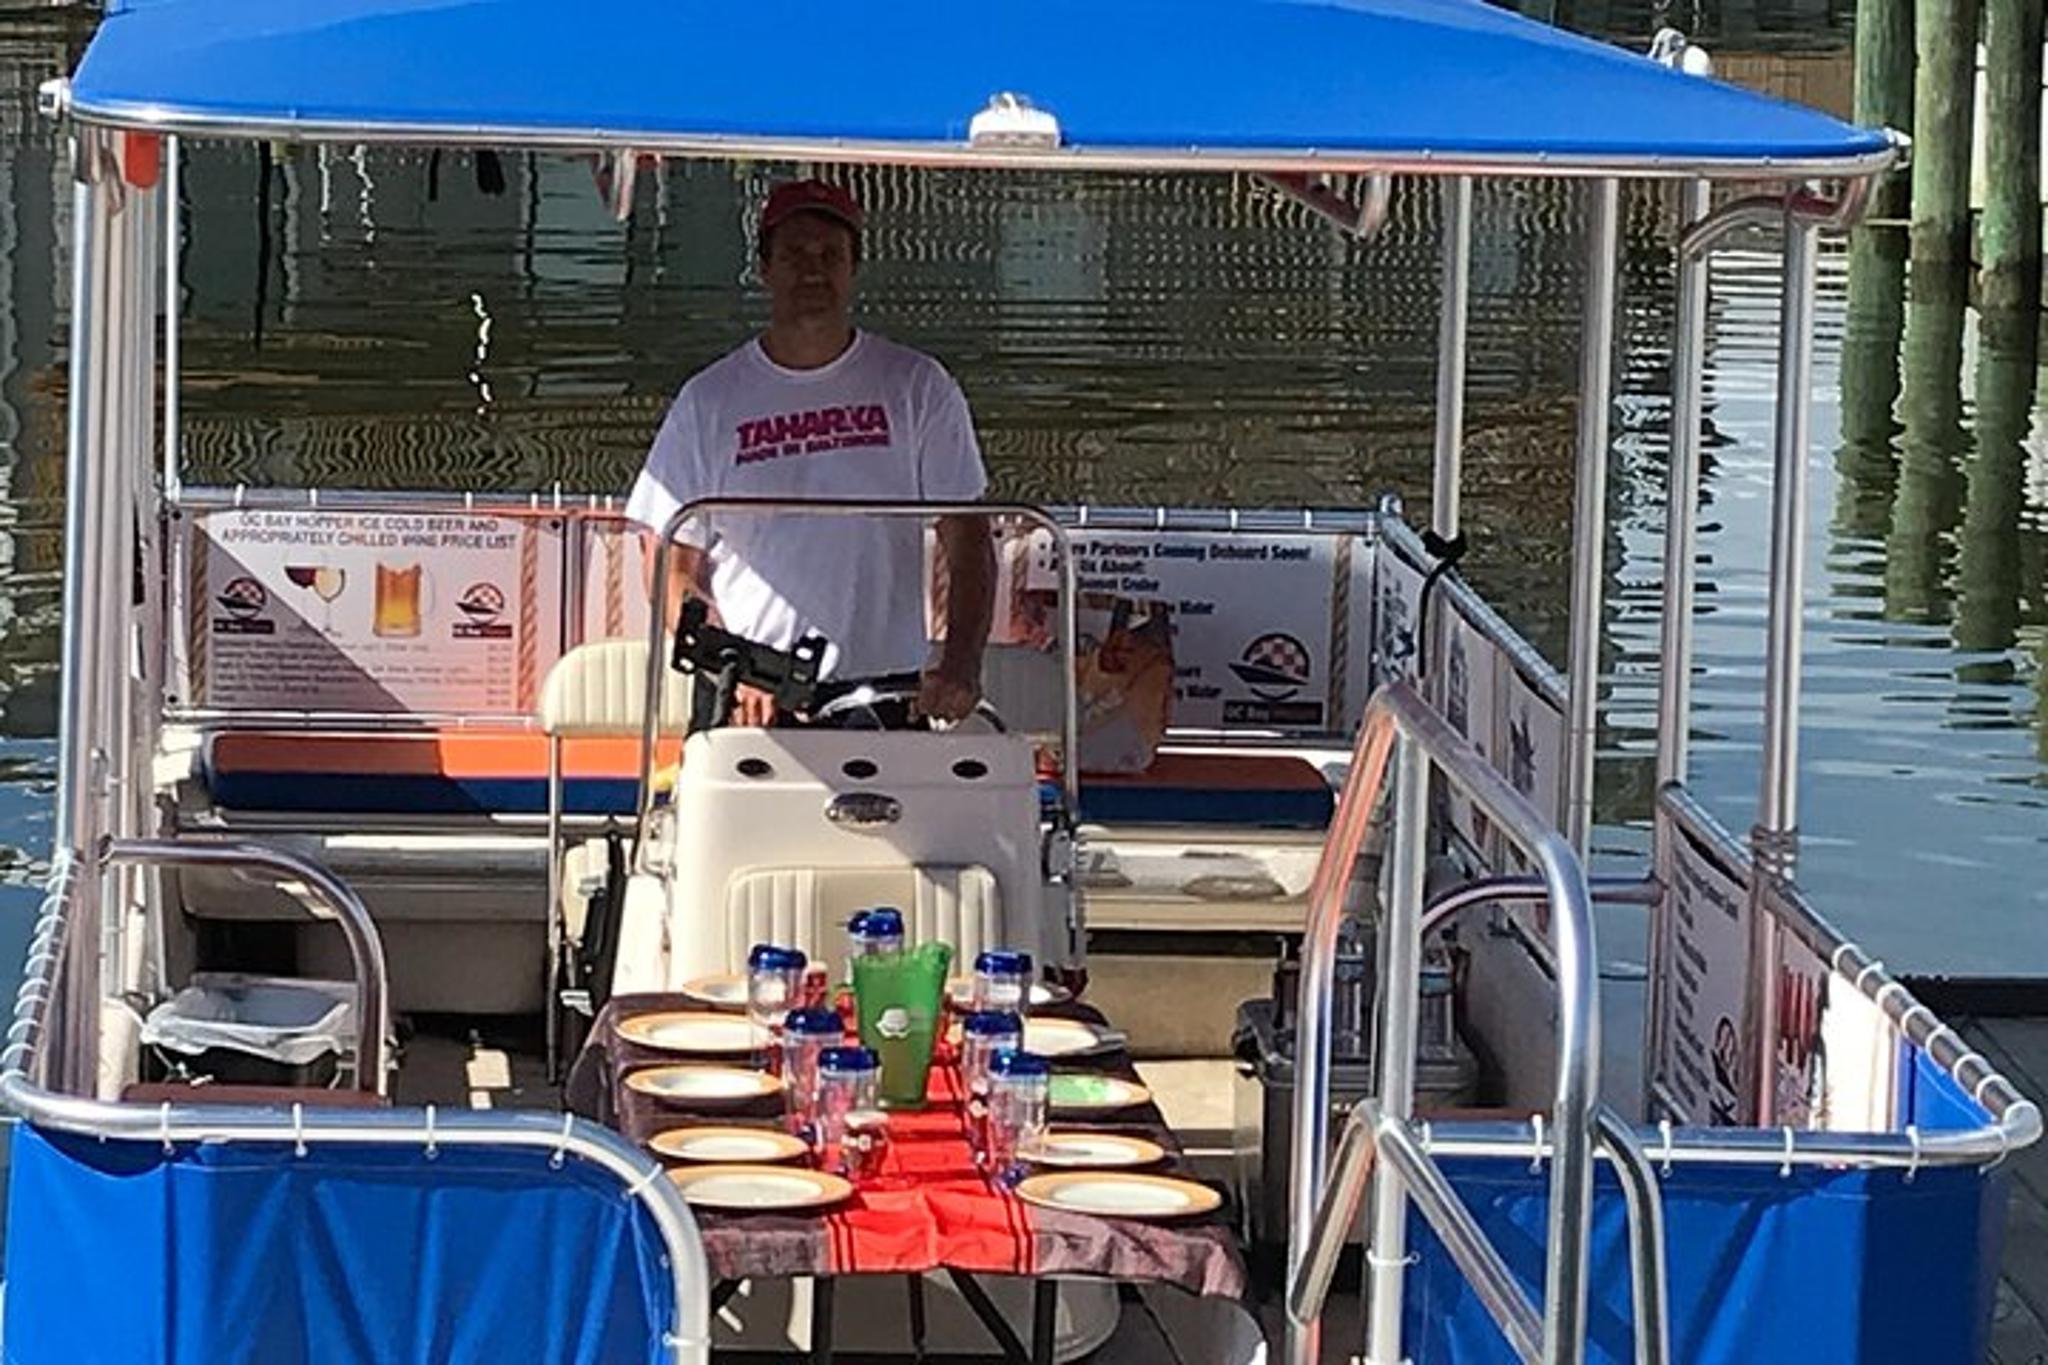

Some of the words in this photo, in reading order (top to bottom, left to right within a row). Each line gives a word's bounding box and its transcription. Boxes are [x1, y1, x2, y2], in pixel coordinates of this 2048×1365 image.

[264, 513, 292, 528] BAY
[296, 514, 354, 530] HOPPER
[358, 515, 380, 530] ICE
[383, 516, 424, 532] COLD
[427, 517, 465, 533] BEER
[468, 518, 499, 534] AND
[221, 528, 334, 546] APPROPRIATELY
[337, 531, 398, 548] CHILLED
[402, 533, 438, 548] WINE
[440, 533, 482, 550] PRICE
[486, 534, 517, 550] LIST
[1090, 541, 1149, 558] Partners
[1154, 542, 1206, 563] Coming
[1209, 542, 1268, 561] Onboard
[1122, 577, 1160, 593] Cruise
